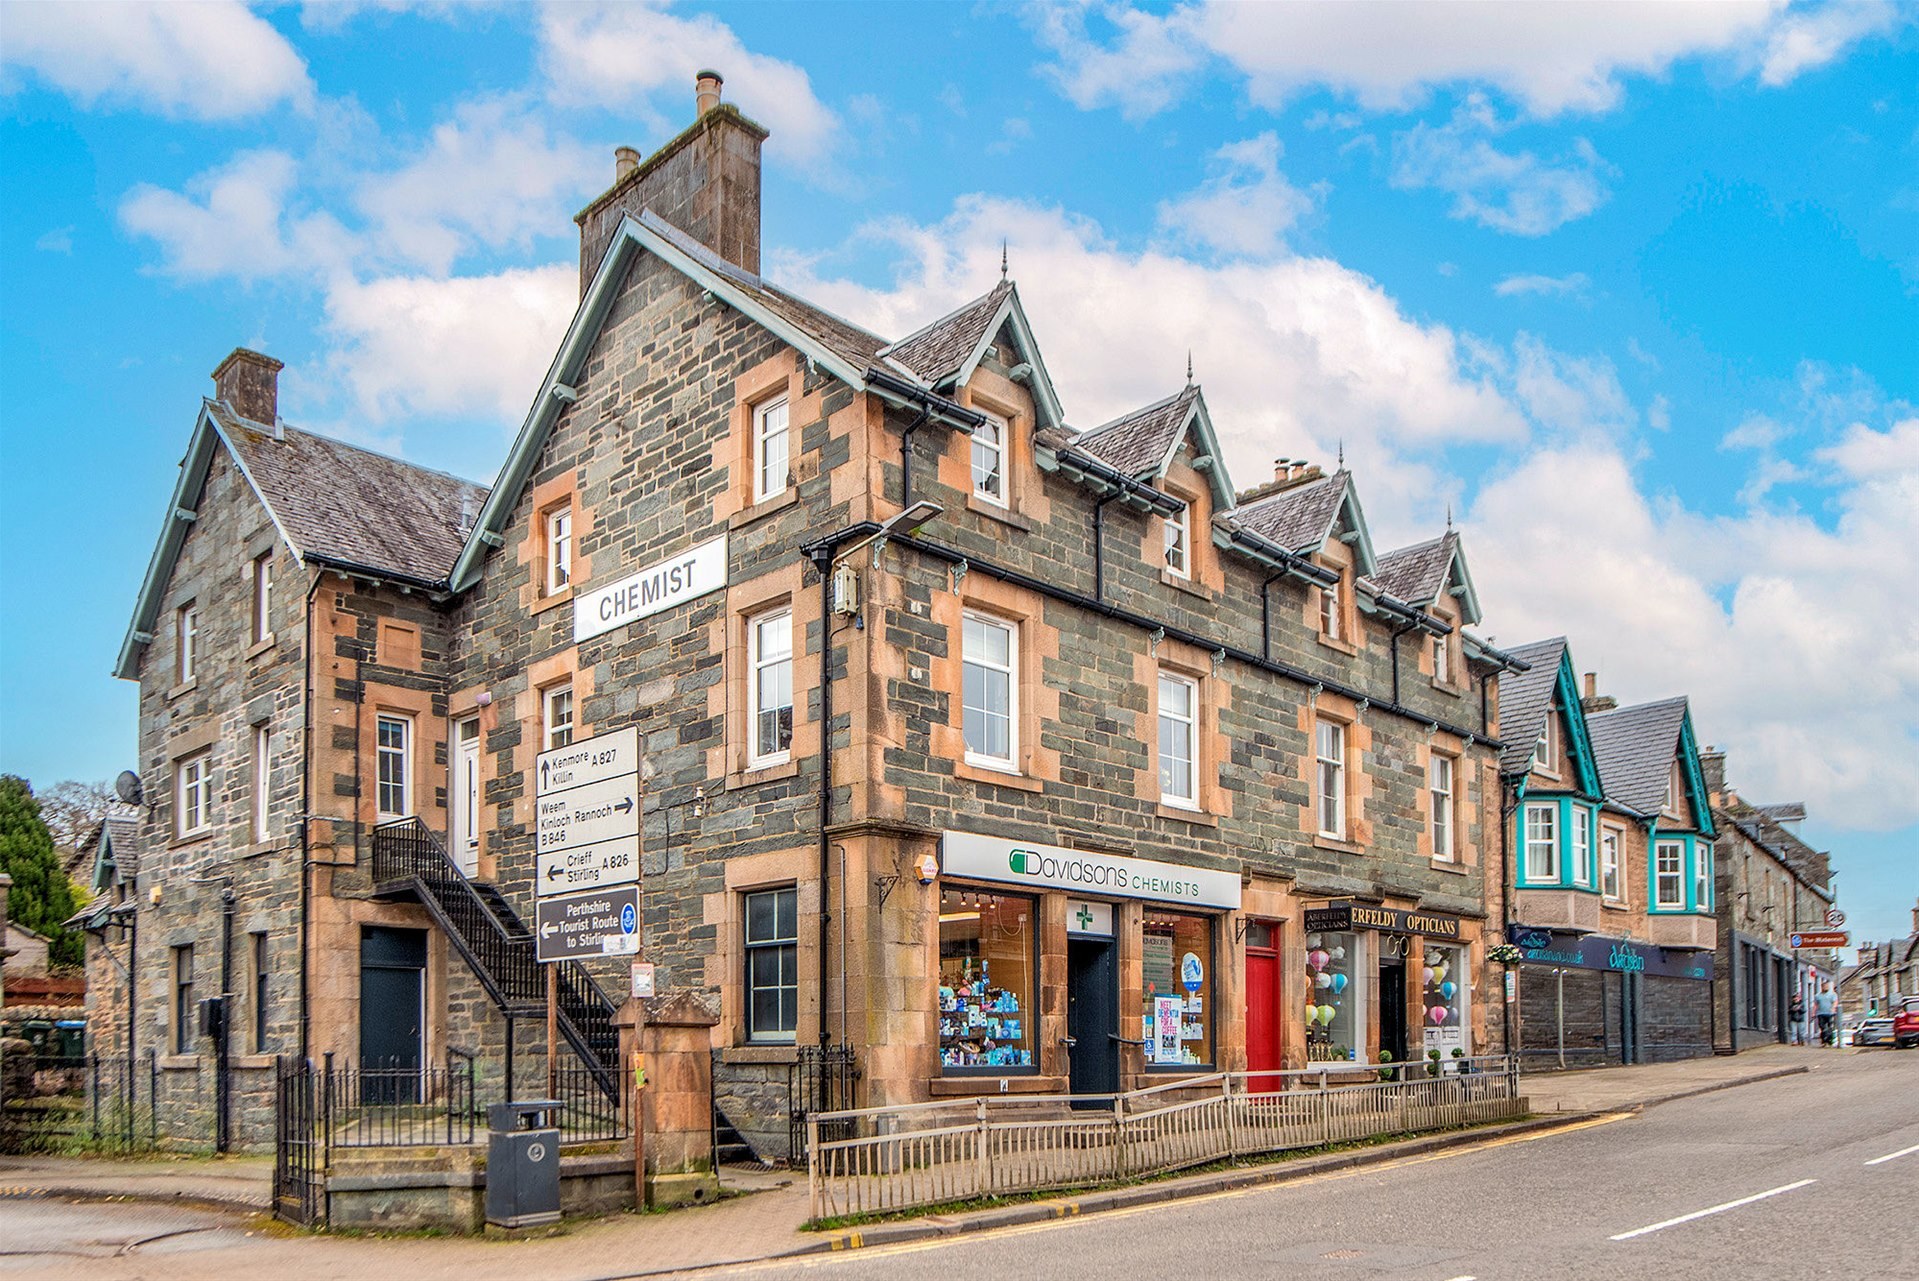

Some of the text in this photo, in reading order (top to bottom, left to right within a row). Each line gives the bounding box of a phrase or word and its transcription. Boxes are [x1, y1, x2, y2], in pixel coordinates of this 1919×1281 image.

[600, 559, 696, 621] CHEMIST
[552, 751, 589, 770] Kenmore
[552, 771, 573, 786] Killin
[541, 801, 566, 815] Weem
[541, 804, 612, 831] Kinloch Rannoch
[567, 851, 592, 867] Crieff
[567, 868, 600, 883] Stirling
[1132, 875, 1199, 897] CHEMISTS
[566, 900, 611, 917] Perthshire
[559, 915, 619, 934] Tourist Route
[1307, 920, 1349, 930] OPTICIANS
[1352, 907, 1455, 935] ERFELDY OPTICIANS
[566, 935, 577, 948] to
[579, 933, 606, 948] Stirlin
